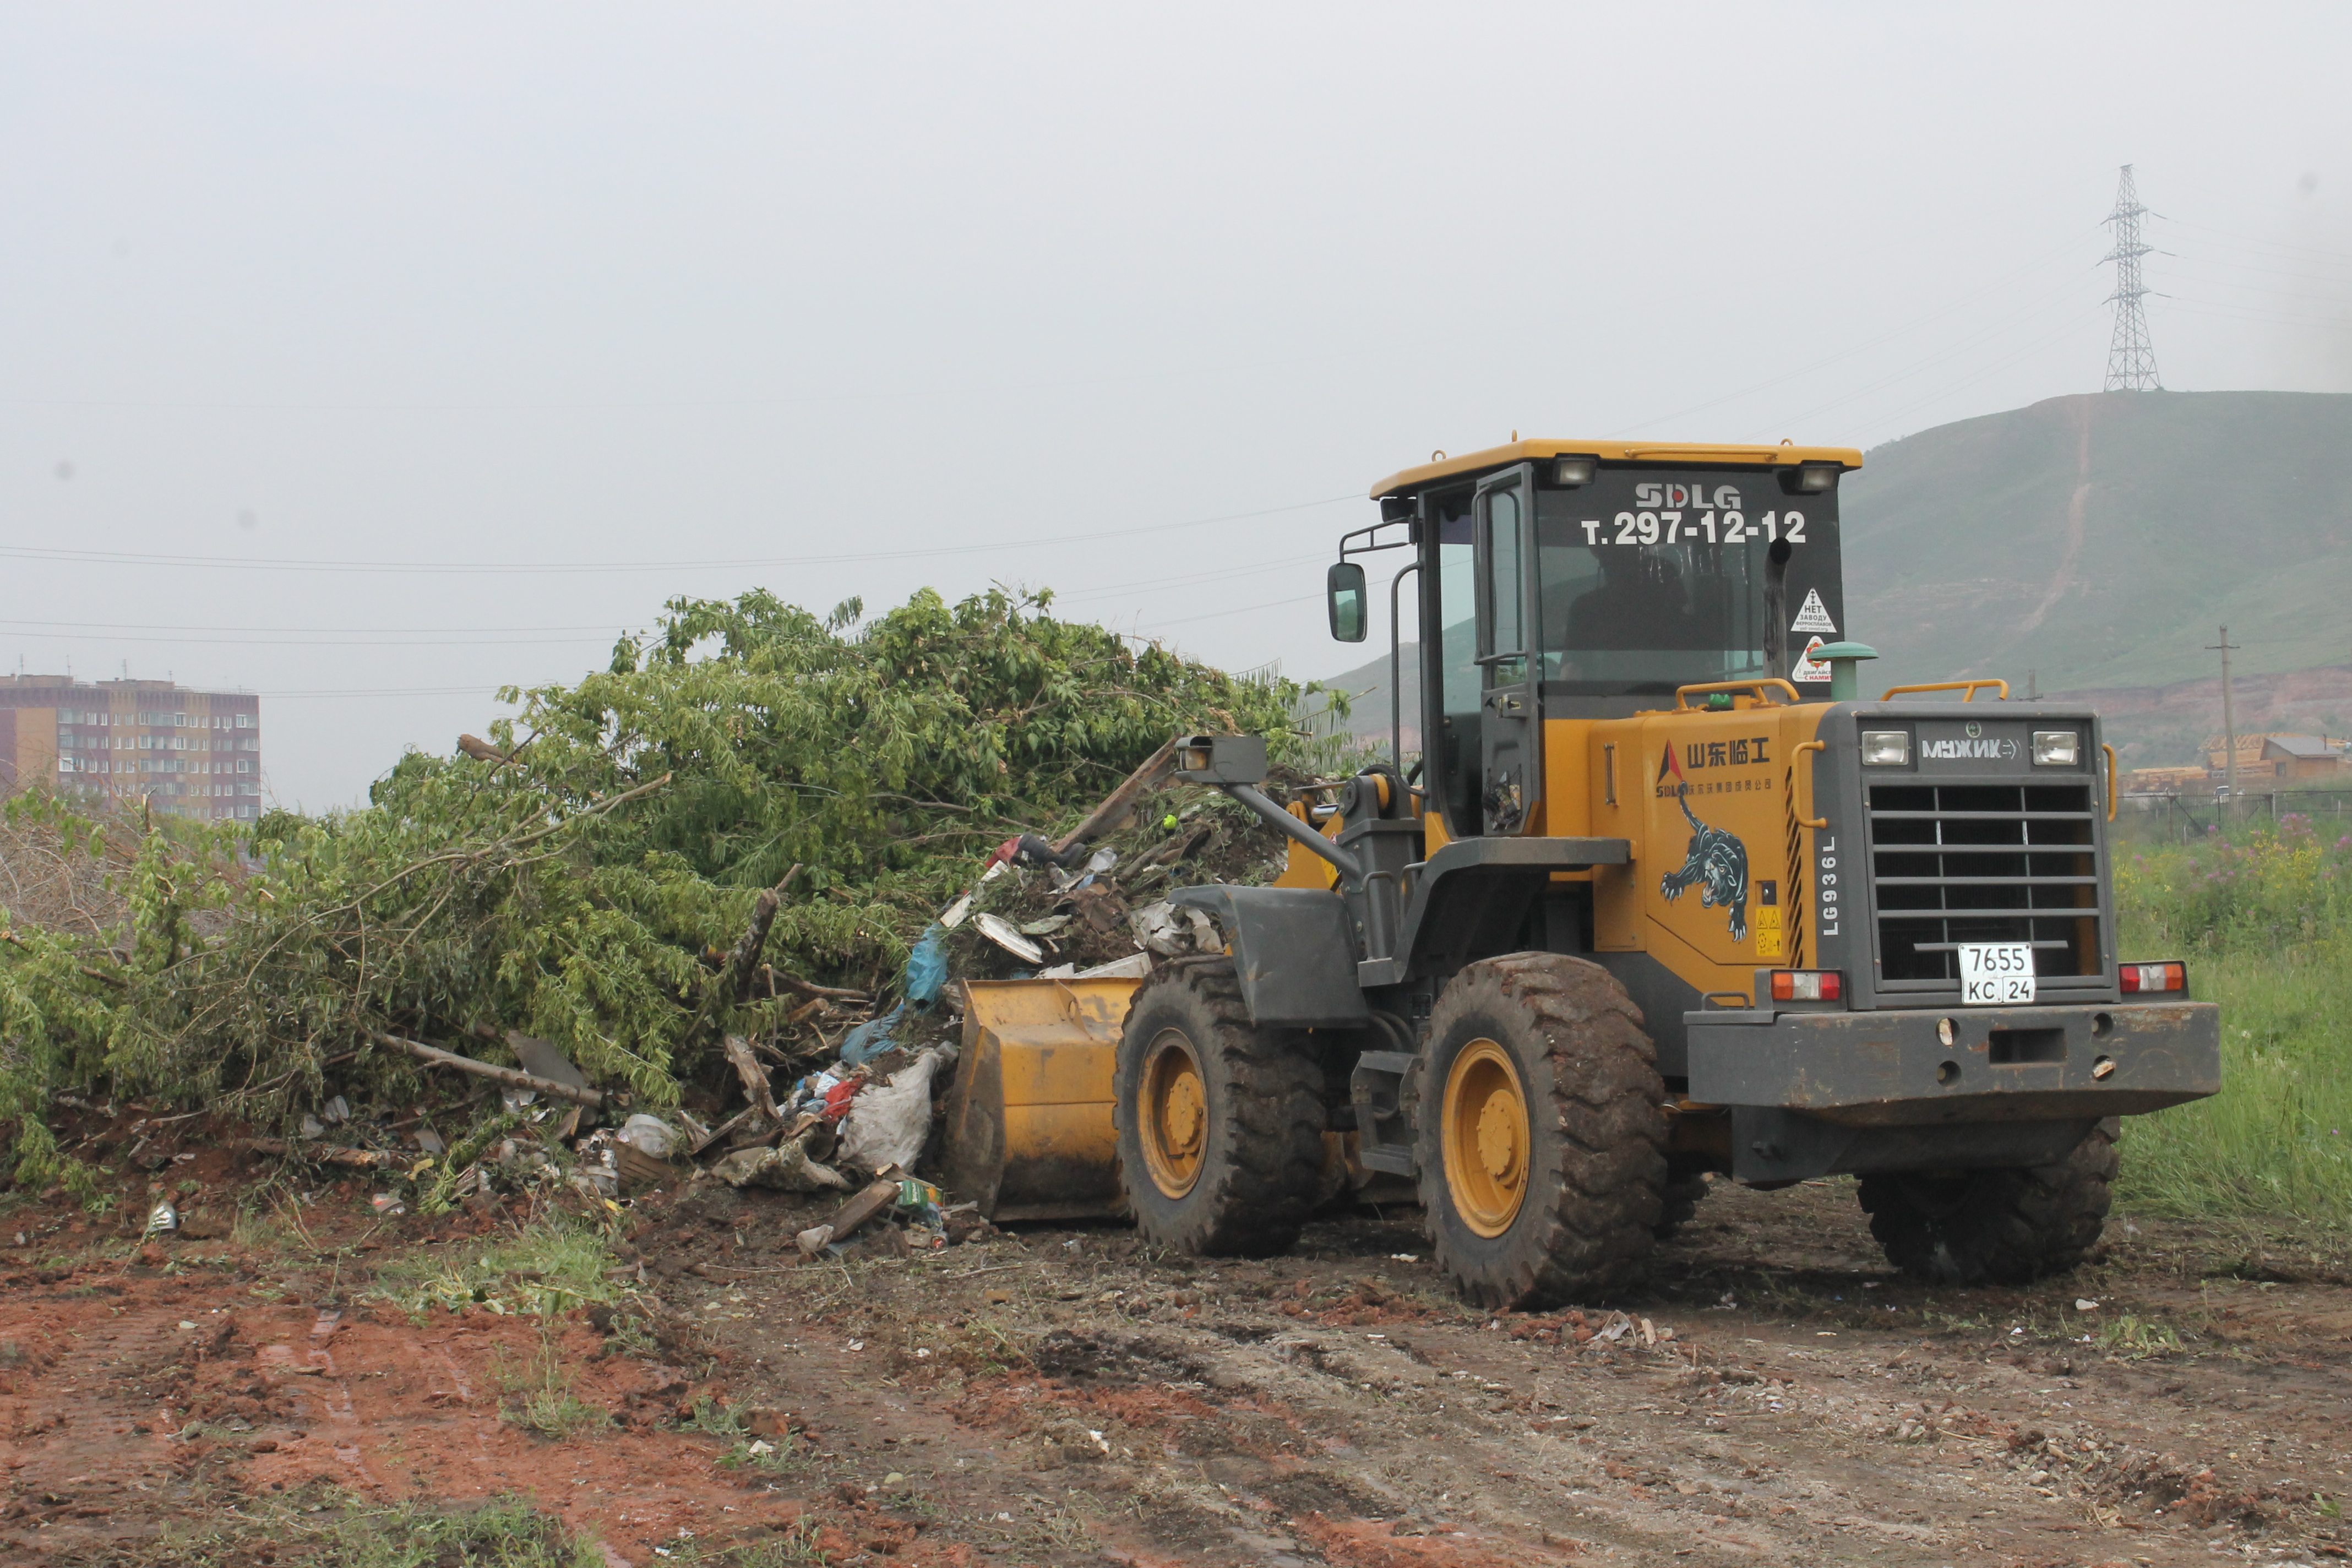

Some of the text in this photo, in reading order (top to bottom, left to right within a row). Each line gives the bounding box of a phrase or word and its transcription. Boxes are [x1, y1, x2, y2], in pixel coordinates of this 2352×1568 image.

[1635, 483, 1741, 509] SDLG
[1805, 605, 1822, 613] НЕТ
[1687, 737, 1770, 769] 山东临工
[1656, 785, 1688, 798] SDL
[1821, 836, 1838, 935] LG936L
[1969, 948, 2024, 971] 7655
[2009, 981, 2029, 999] 24
